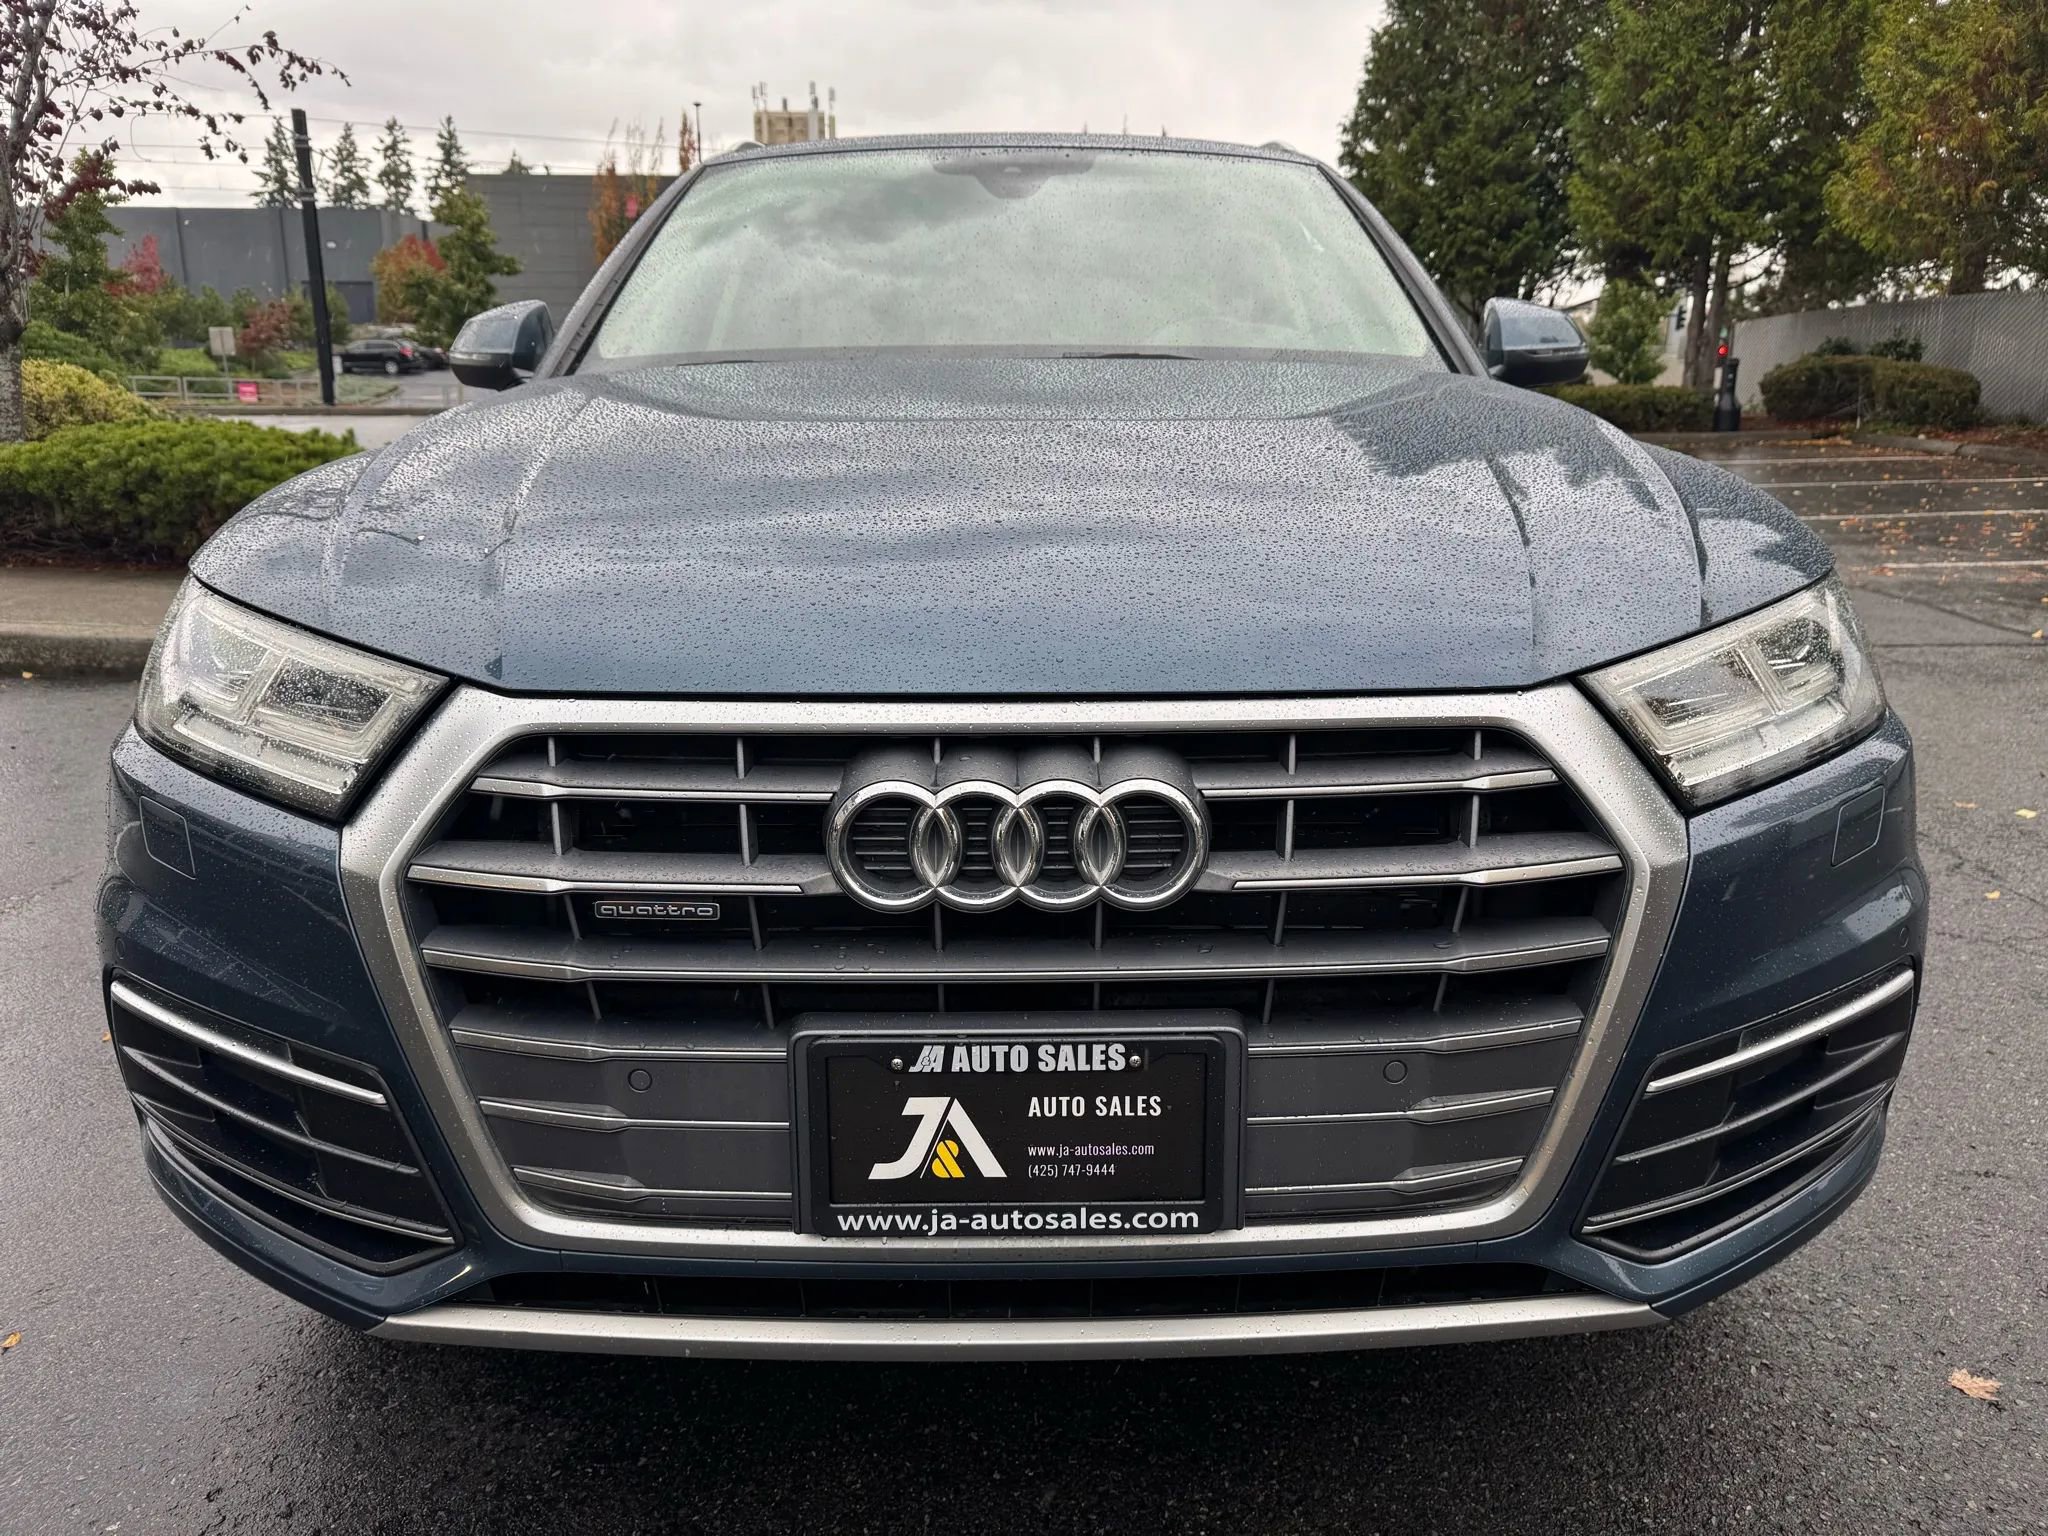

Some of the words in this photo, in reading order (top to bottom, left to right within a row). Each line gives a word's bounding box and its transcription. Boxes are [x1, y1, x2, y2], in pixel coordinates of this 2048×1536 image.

[600, 904, 713, 917] quattro
[951, 1044, 1029, 1073] AUTO
[1038, 1043, 1126, 1072] SALES
[1028, 1096, 1086, 1117] AUTO
[1095, 1095, 1162, 1116] SALES
[1027, 1142, 1155, 1157] www.ja-autosales.com
[1028, 1164, 1058, 1178] (425)
[1061, 1164, 1115, 1177] 747-9444
[837, 1206, 1199, 1236] www.ja-autosales.com
